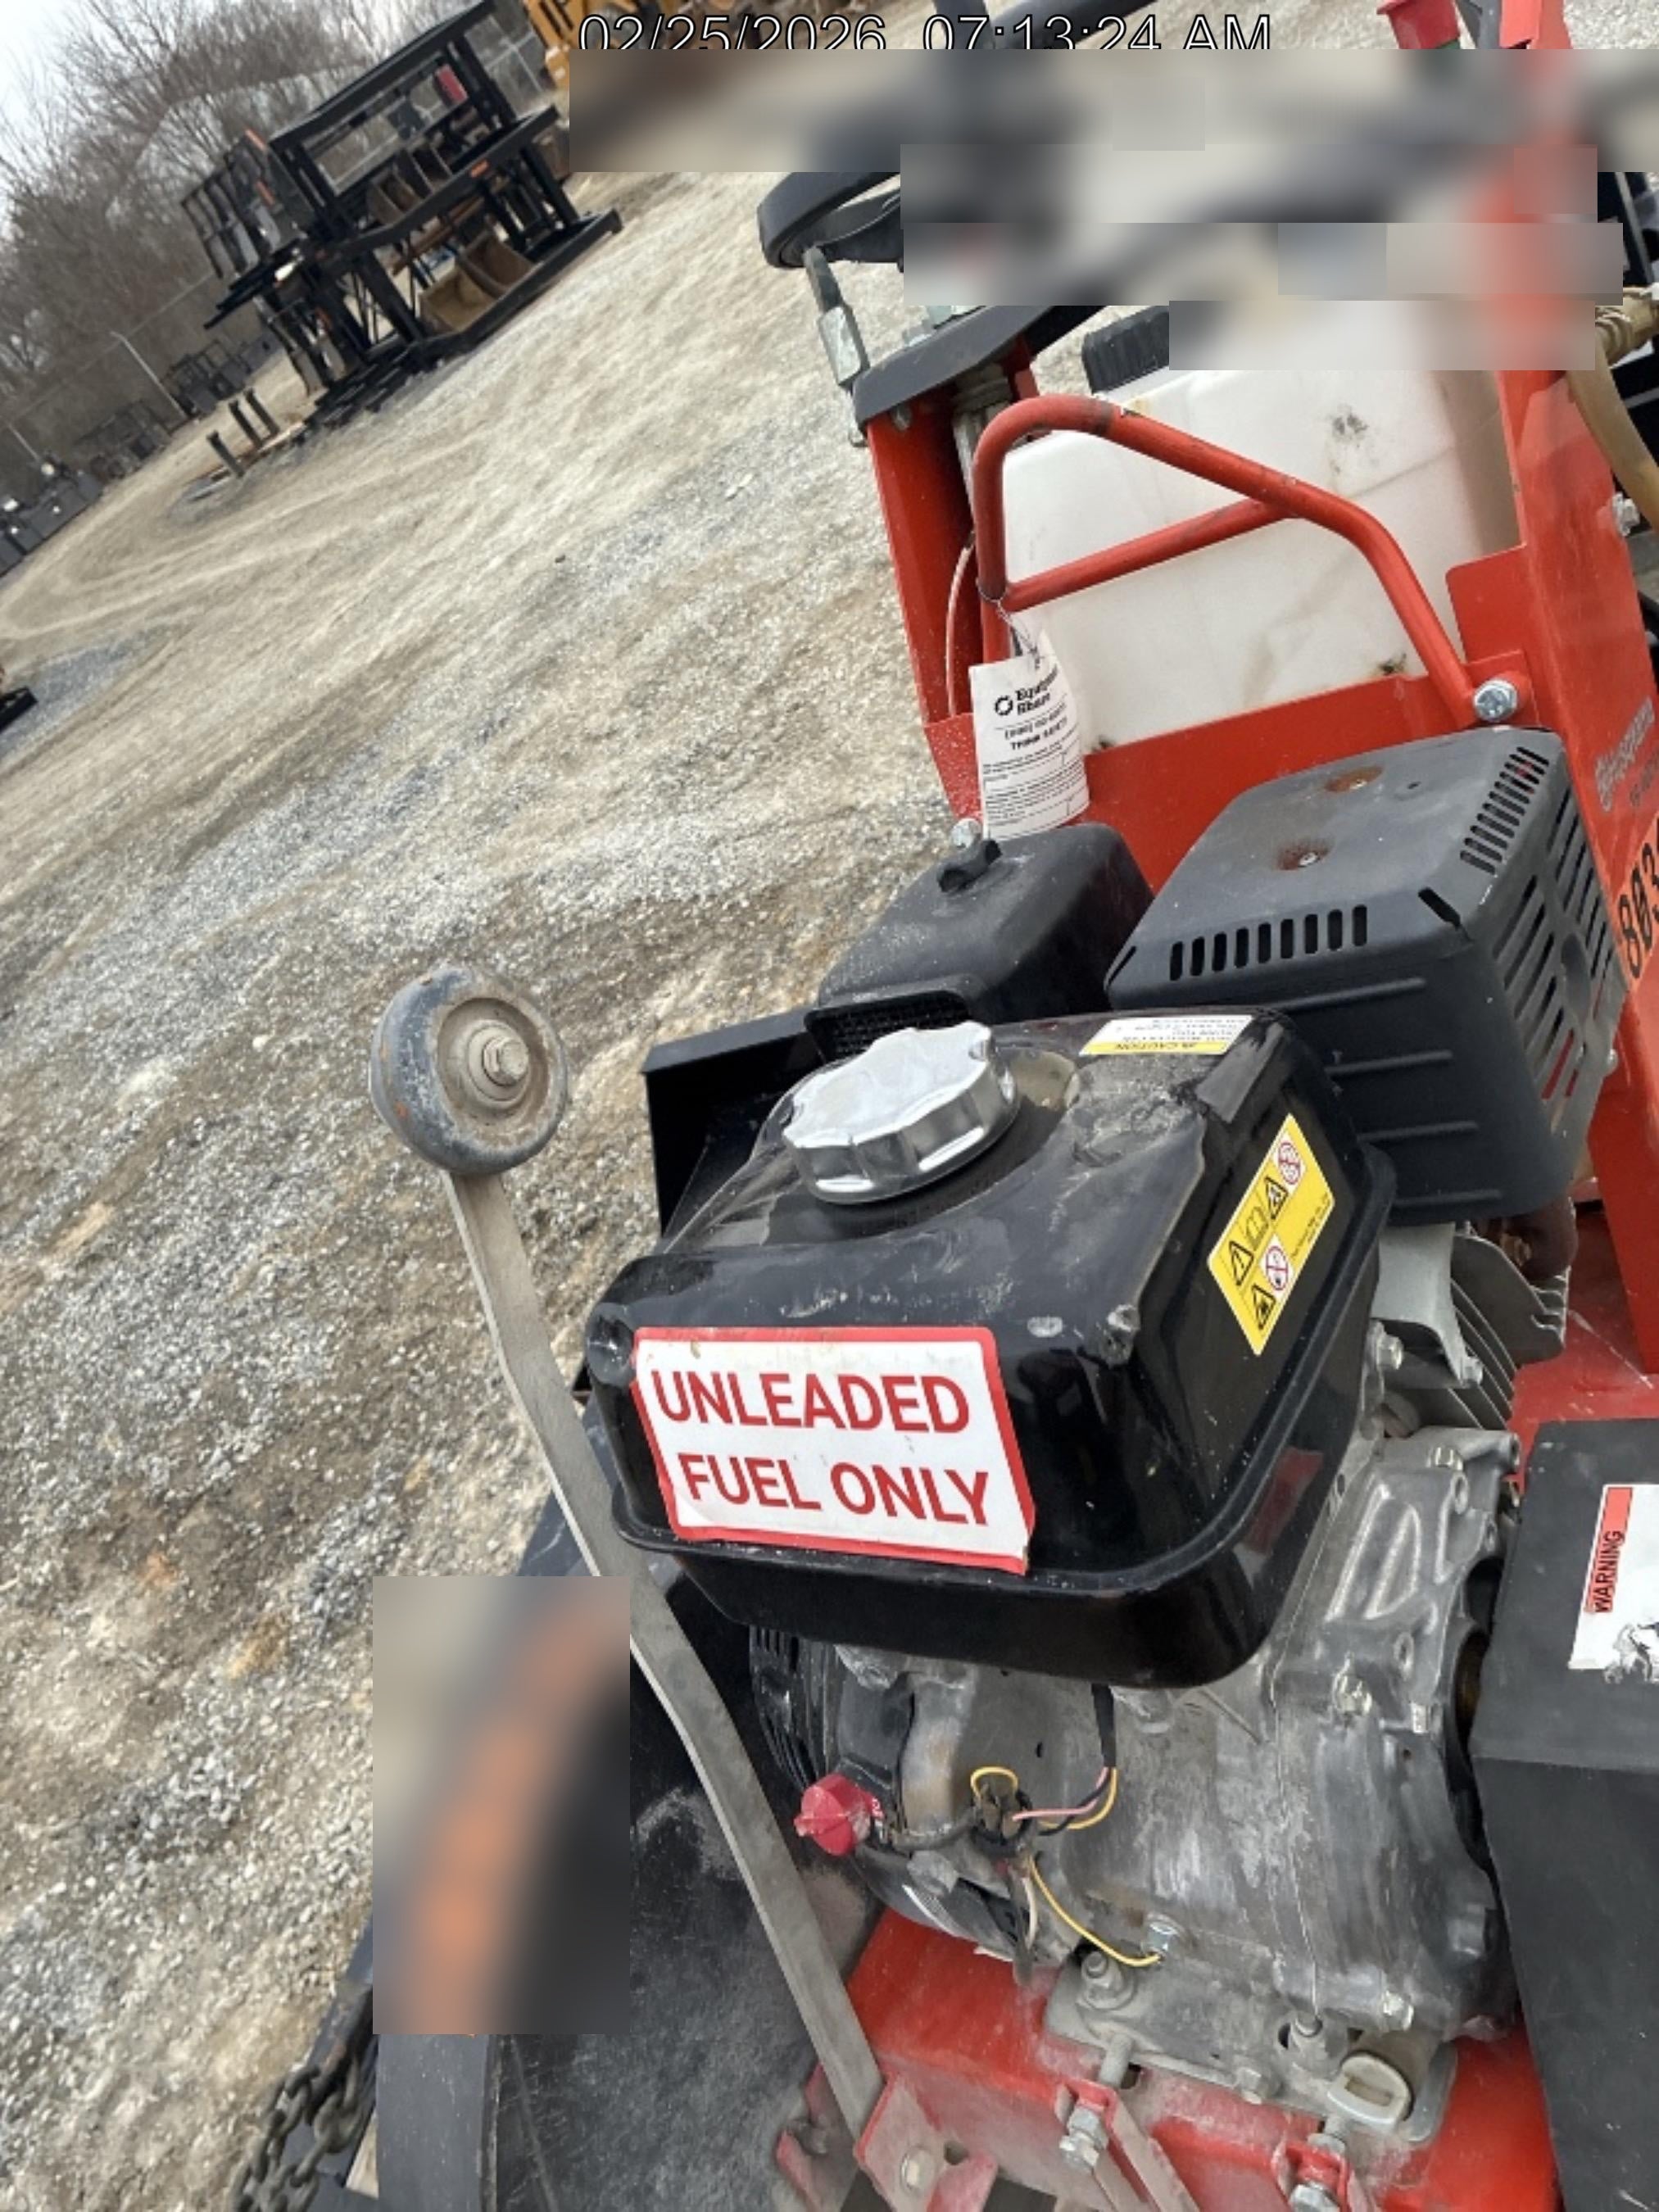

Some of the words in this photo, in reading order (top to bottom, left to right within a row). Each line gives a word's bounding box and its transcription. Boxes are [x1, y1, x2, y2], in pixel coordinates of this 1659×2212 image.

[651, 1370, 969, 1434] UNLEADED
[678, 1453, 821, 1511] FUEL
[831, 1462, 989, 1525] ONLY
[1593, 1530, 1625, 1612] WARNING
